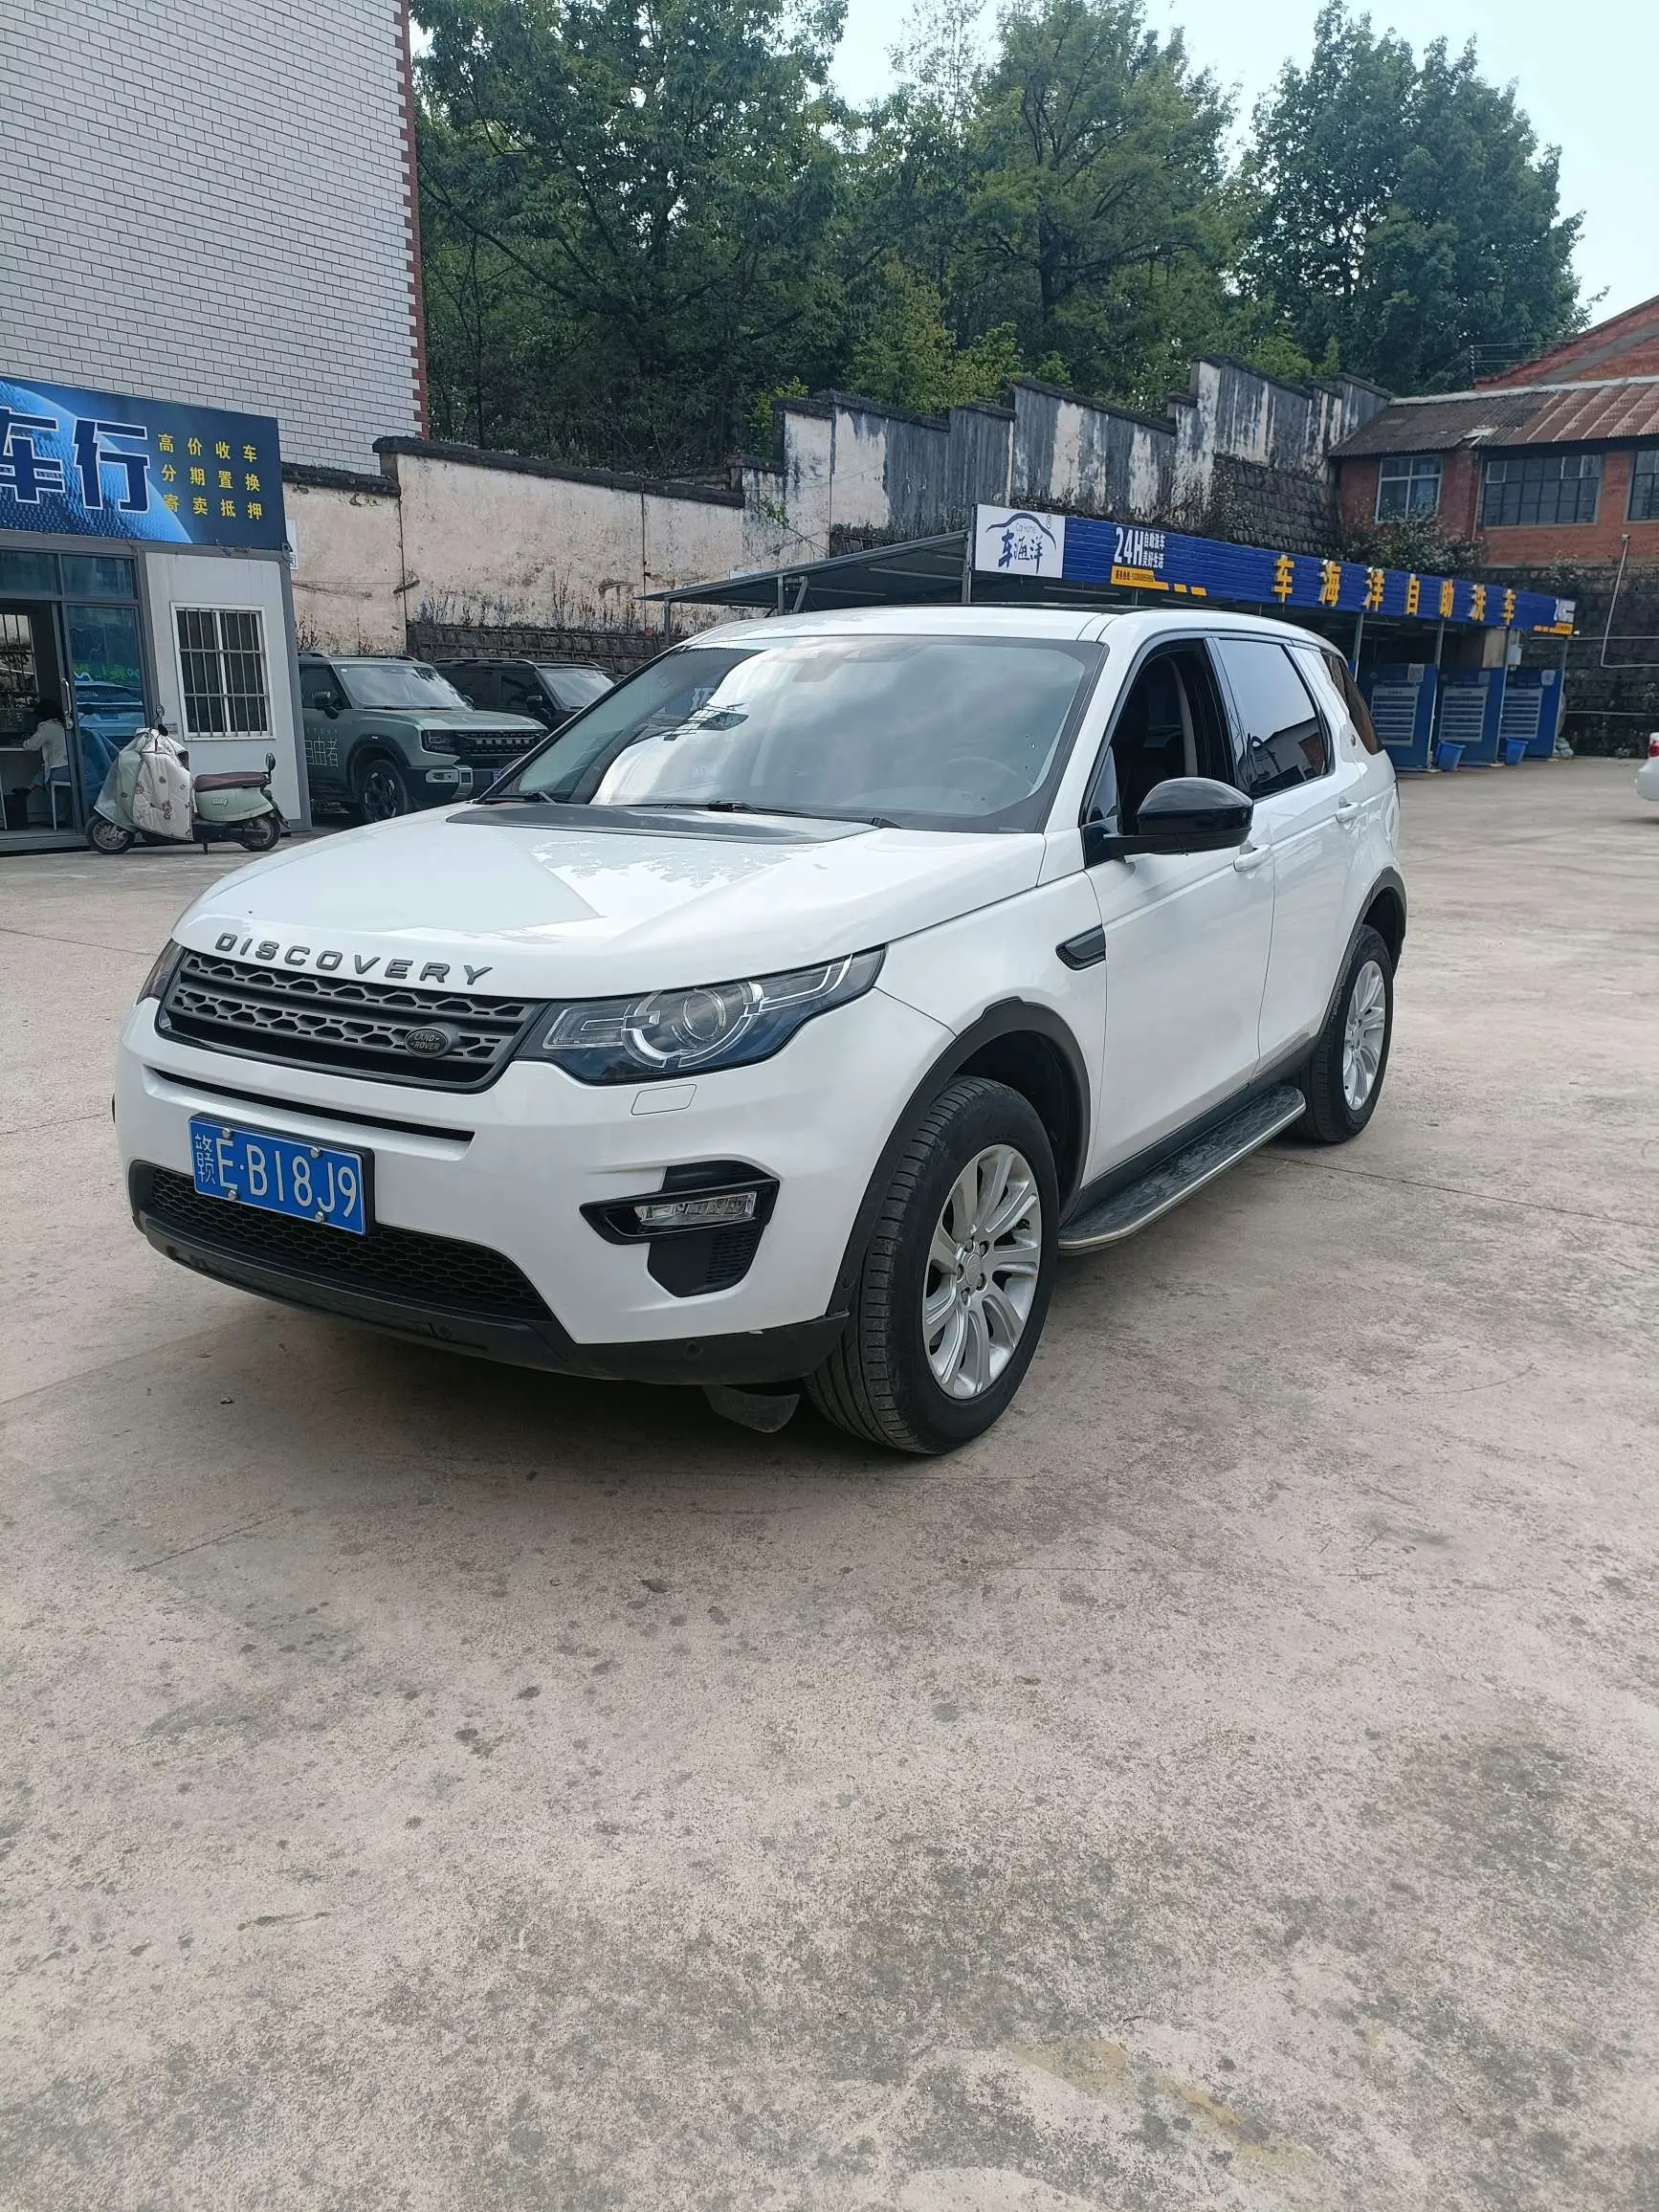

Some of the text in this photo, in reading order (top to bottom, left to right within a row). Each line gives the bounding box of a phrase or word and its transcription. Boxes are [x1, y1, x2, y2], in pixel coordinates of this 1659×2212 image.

[158, 433, 257, 463] 高价收车
[161, 464, 261, 493] 分期置换
[164, 494, 263, 520] 寄卖抵押
[1114, 526, 1144, 566] 24H
[1273, 554, 1516, 627] 车海洋自助洗车
[214, 932, 493, 985] DISCOVERY
